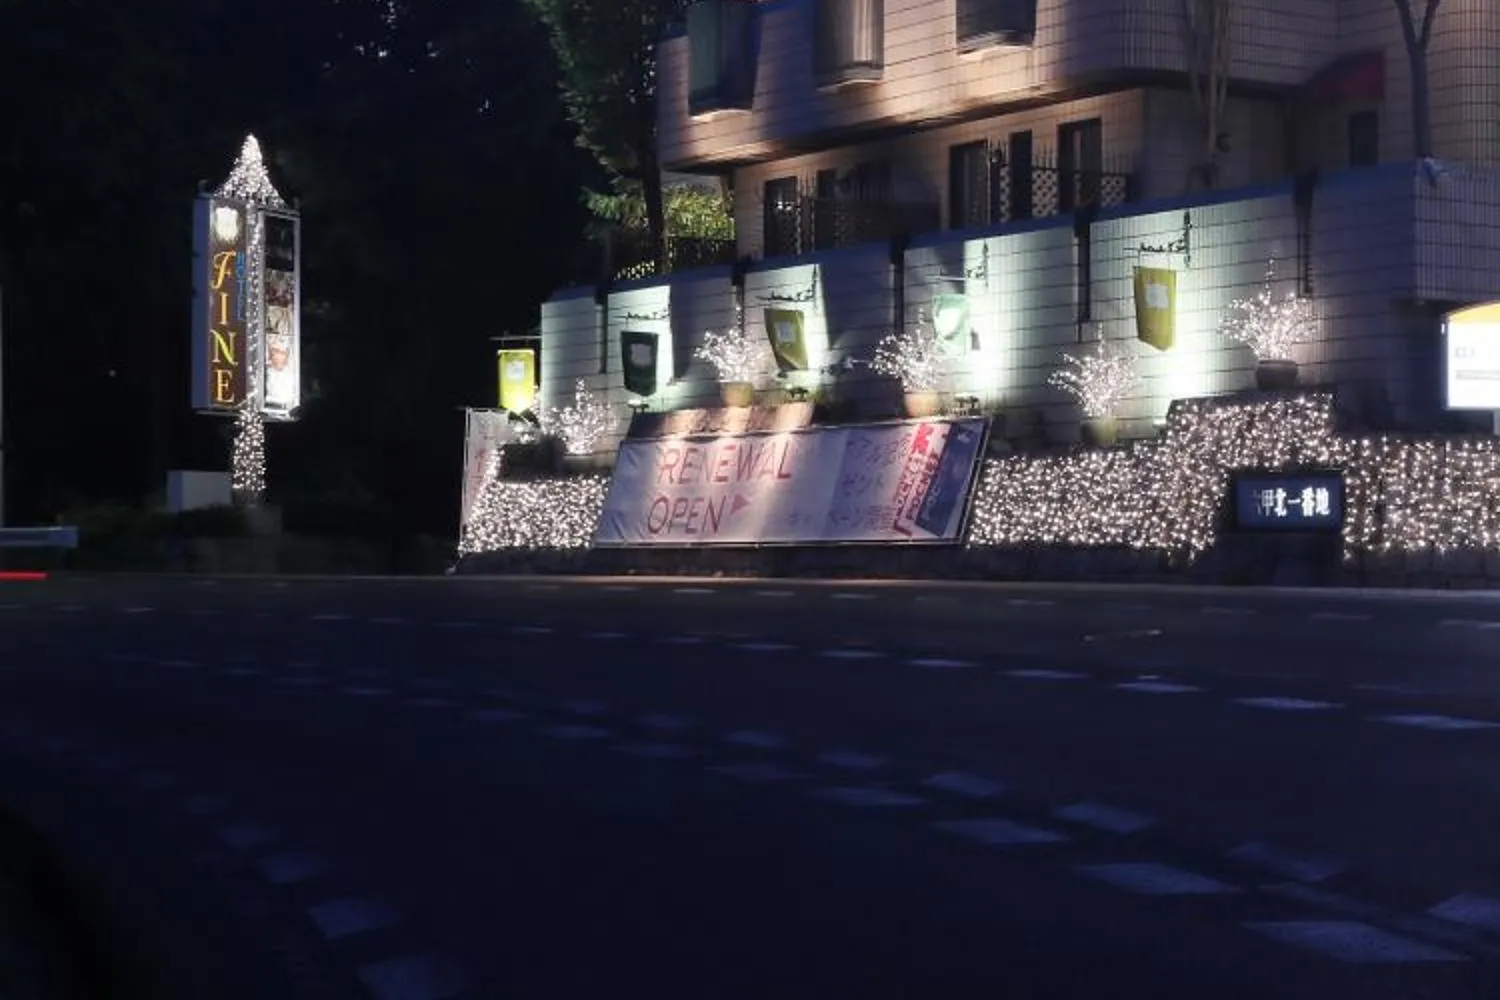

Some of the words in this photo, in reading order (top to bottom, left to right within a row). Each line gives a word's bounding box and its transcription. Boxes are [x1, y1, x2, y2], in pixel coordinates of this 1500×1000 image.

[211, 251, 239, 403] FINE
[658, 439, 793, 484] RENEWAL
[646, 495, 727, 536] OPEN
